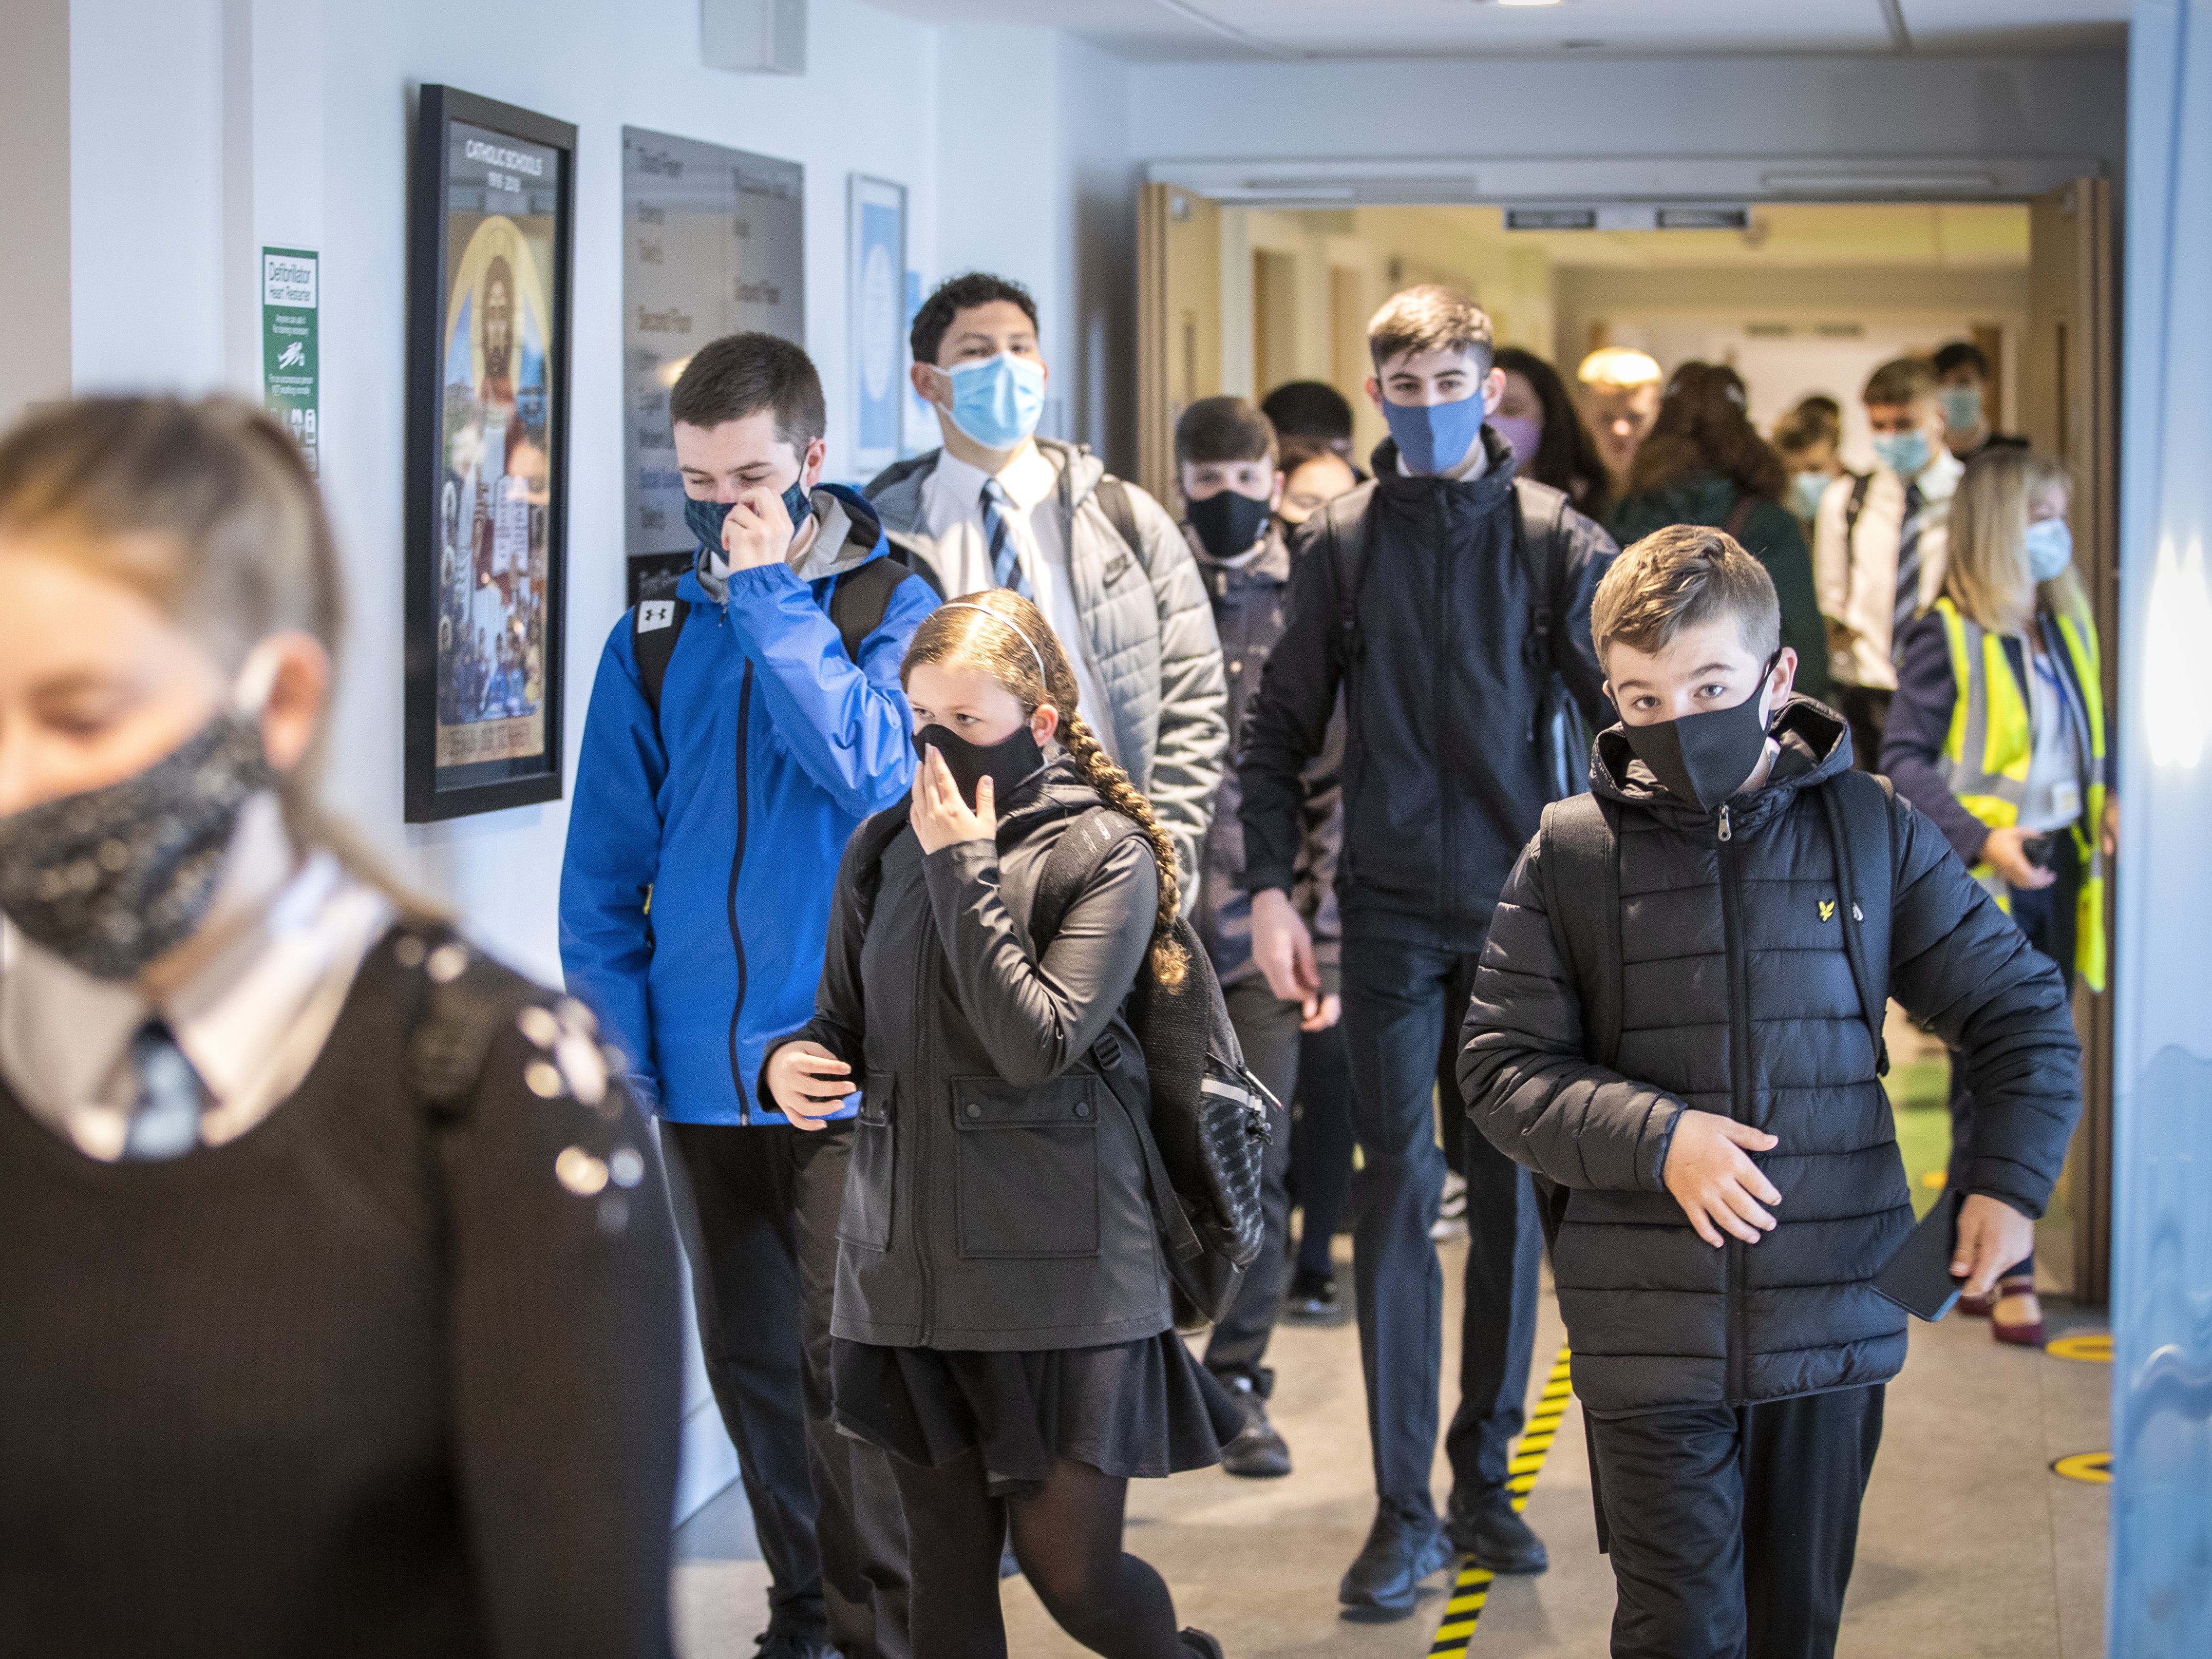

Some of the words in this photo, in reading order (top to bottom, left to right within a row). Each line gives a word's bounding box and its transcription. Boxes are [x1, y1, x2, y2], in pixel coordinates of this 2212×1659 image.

[466, 139, 506, 166] CATHOLIC
[506, 150, 543, 176] SCHOOLS
[269, 262, 311, 284] Defibrillator
[269, 285, 284, 299] Heart
[286, 286, 311, 301] Restarter
